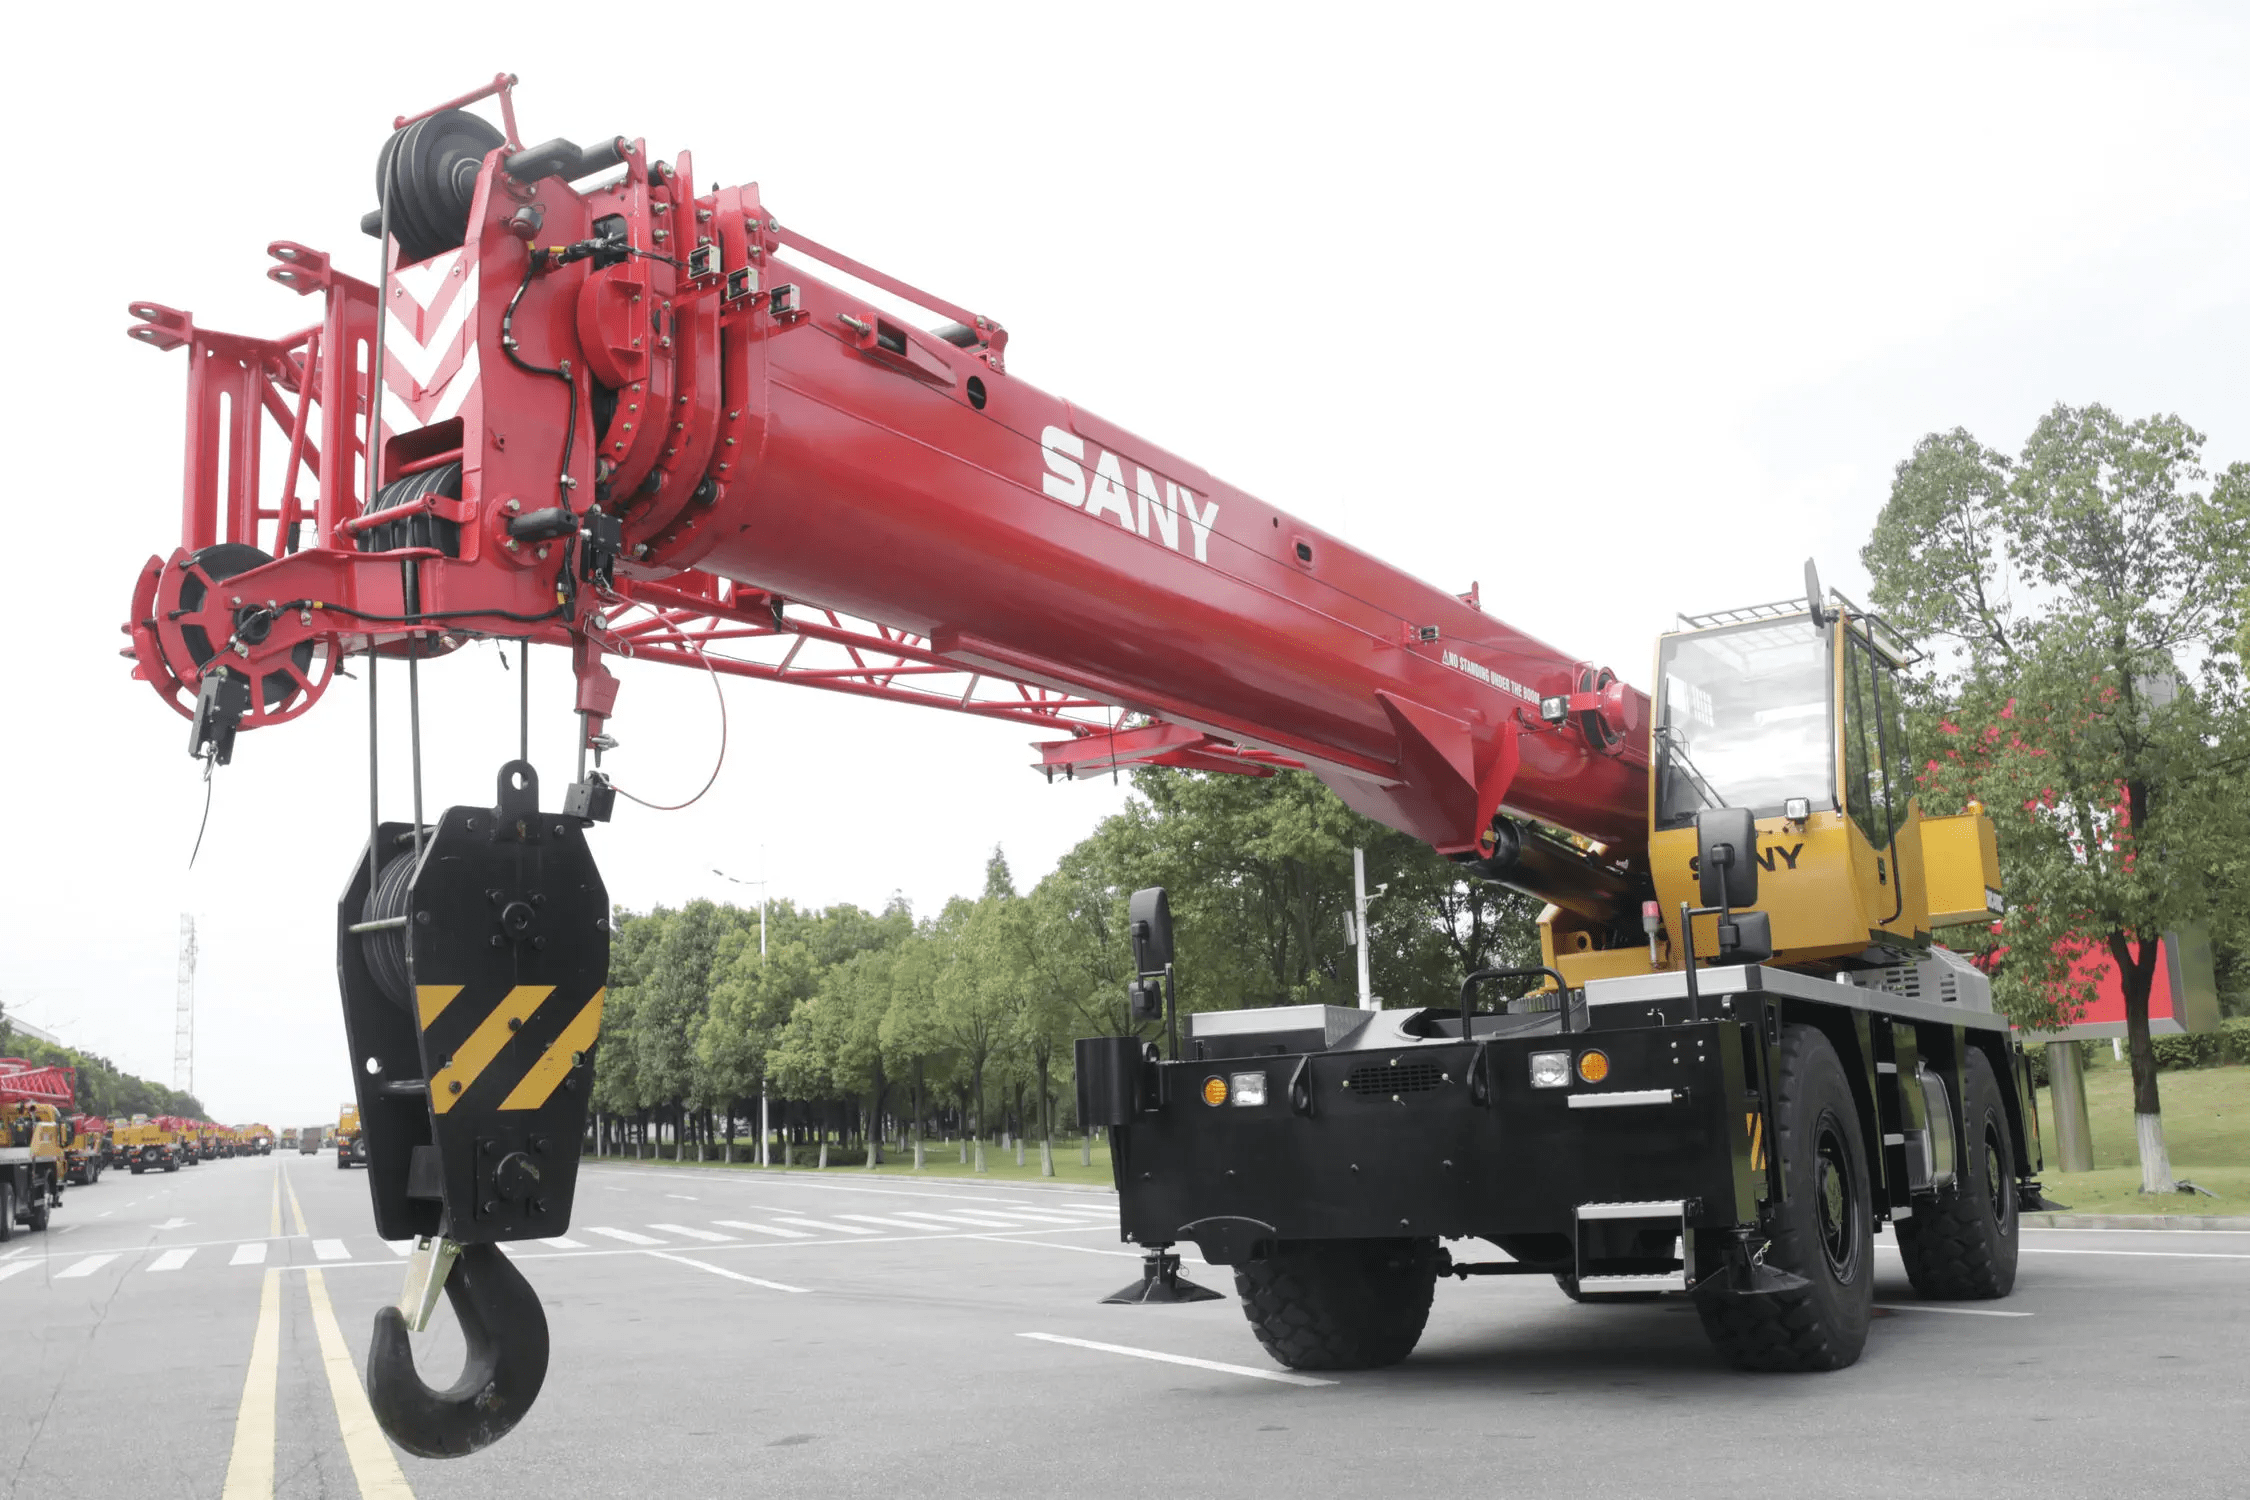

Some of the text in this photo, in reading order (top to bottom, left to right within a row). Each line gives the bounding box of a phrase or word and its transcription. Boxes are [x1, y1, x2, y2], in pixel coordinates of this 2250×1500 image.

[1040, 425, 1219, 563] SANY
[1447, 651, 1459, 669] NO
[1460, 656, 1490, 682] STANDING
[1490, 670, 1511, 692] UNDER
[1511, 680, 1523, 698] THE
[1689, 843, 1804, 880] NY
